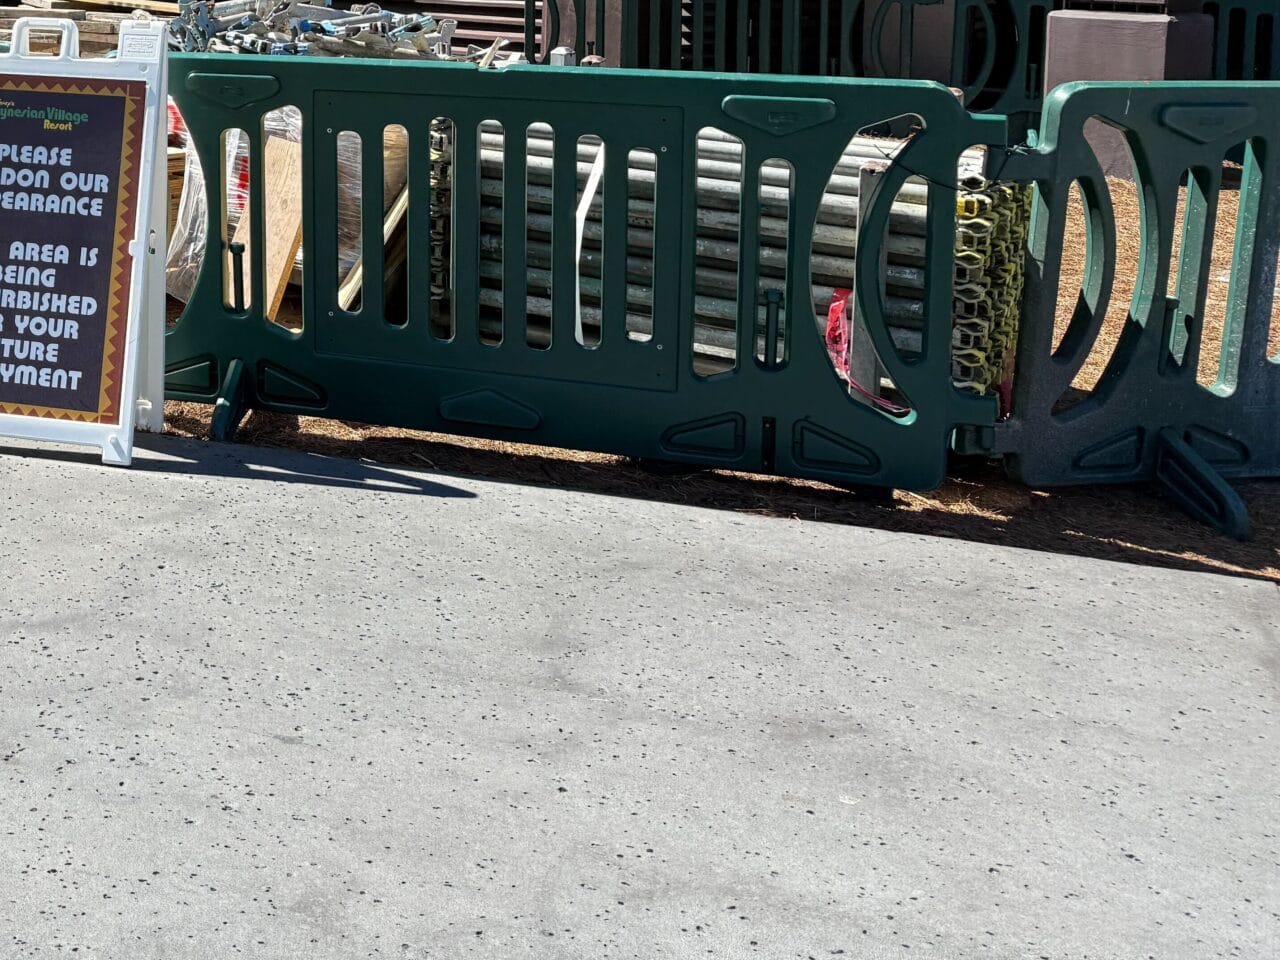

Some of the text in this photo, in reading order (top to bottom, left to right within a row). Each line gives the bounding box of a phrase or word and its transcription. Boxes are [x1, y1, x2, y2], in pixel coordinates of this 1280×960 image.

[43, 119, 73, 132] Resort
[46, 106, 89, 125] Village
[59, 171, 109, 193] OUR
[8, 240, 70, 265] AREA
[79, 246, 99, 267] IS
[14, 314, 80, 340] YOUR
